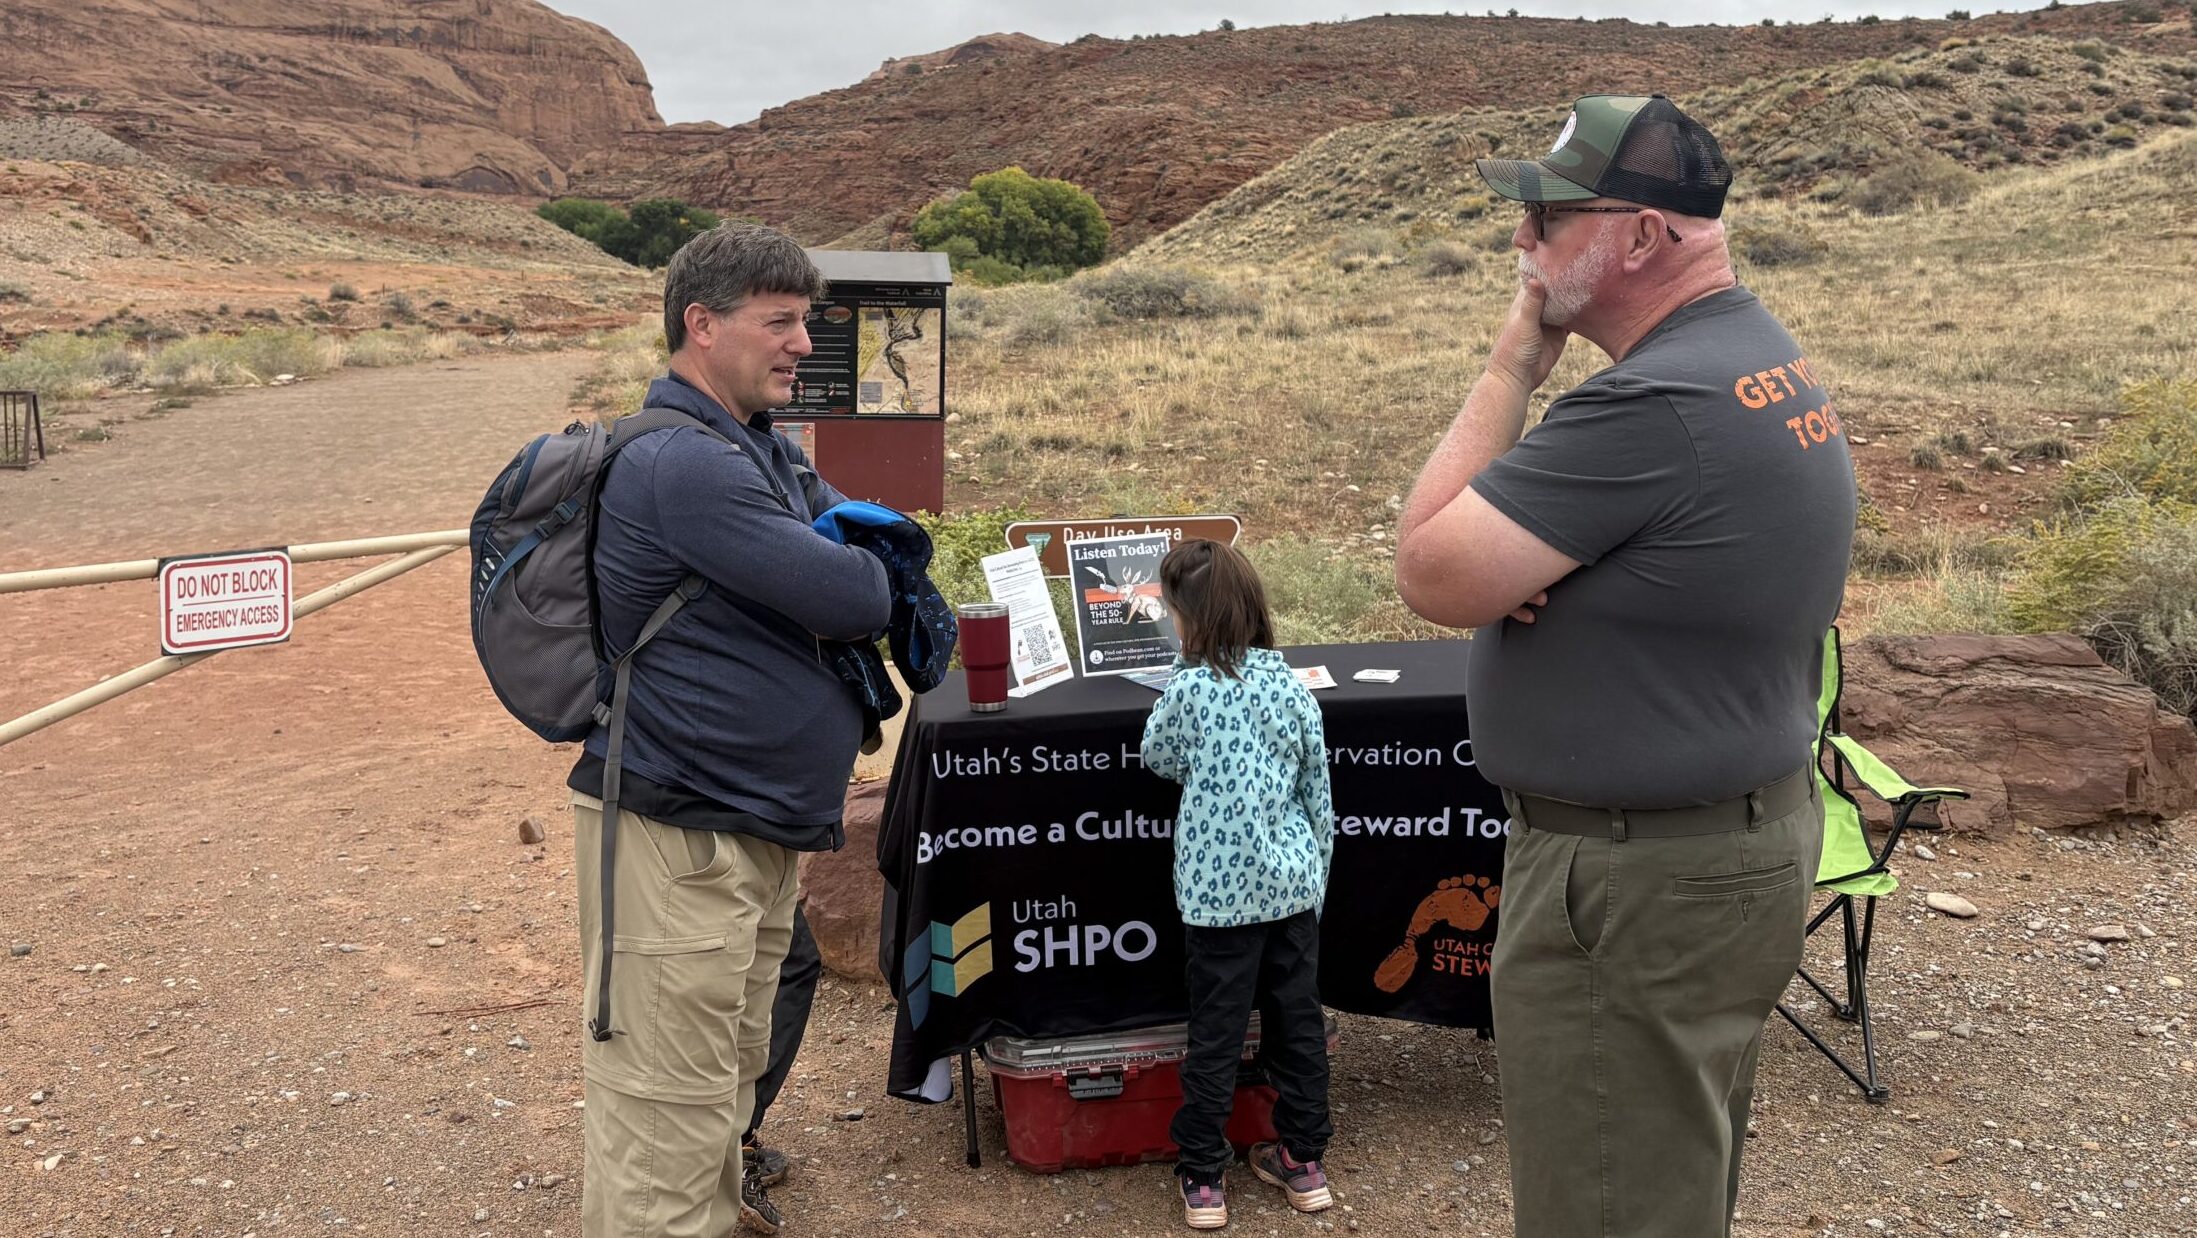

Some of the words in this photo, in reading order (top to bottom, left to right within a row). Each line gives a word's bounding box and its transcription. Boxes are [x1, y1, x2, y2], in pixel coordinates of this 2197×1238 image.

[1734, 366, 1796, 409] GET
[1786, 400, 1840, 449] TOG
[1074, 546, 1116, 561] Listen
[1119, 541, 1166, 558] Today!
[177, 575, 197, 599] DO
[201, 573, 228, 597] NOT
[232, 568, 277, 594] BLOCK
[177, 608, 239, 633] EMERGENCY
[240, 604, 279, 626] ACCESS
[1089, 602, 1122, 611] BEYOND
[1090, 611, 1107, 619] THE
[1108, 609, 1122, 617] 50-
[932, 747, 1022, 779] Utah's
[1031, 745, 1110, 773] State
[1121, 743, 1145, 769] H
[1325, 740, 1441, 766] ervation
[917, 823, 1038, 864] Become
[1047, 823, 1066, 842] a
[1075, 809, 1172, 841] Cultu
[1332, 807, 1450, 837] teward
[1013, 895, 1077, 923] Utah
[1013, 920, 1157, 973] SHPO
[1434, 939, 1479, 956] UTAH
[1482, 943, 1493, 956] C
[1432, 953, 1492, 977] STEW
